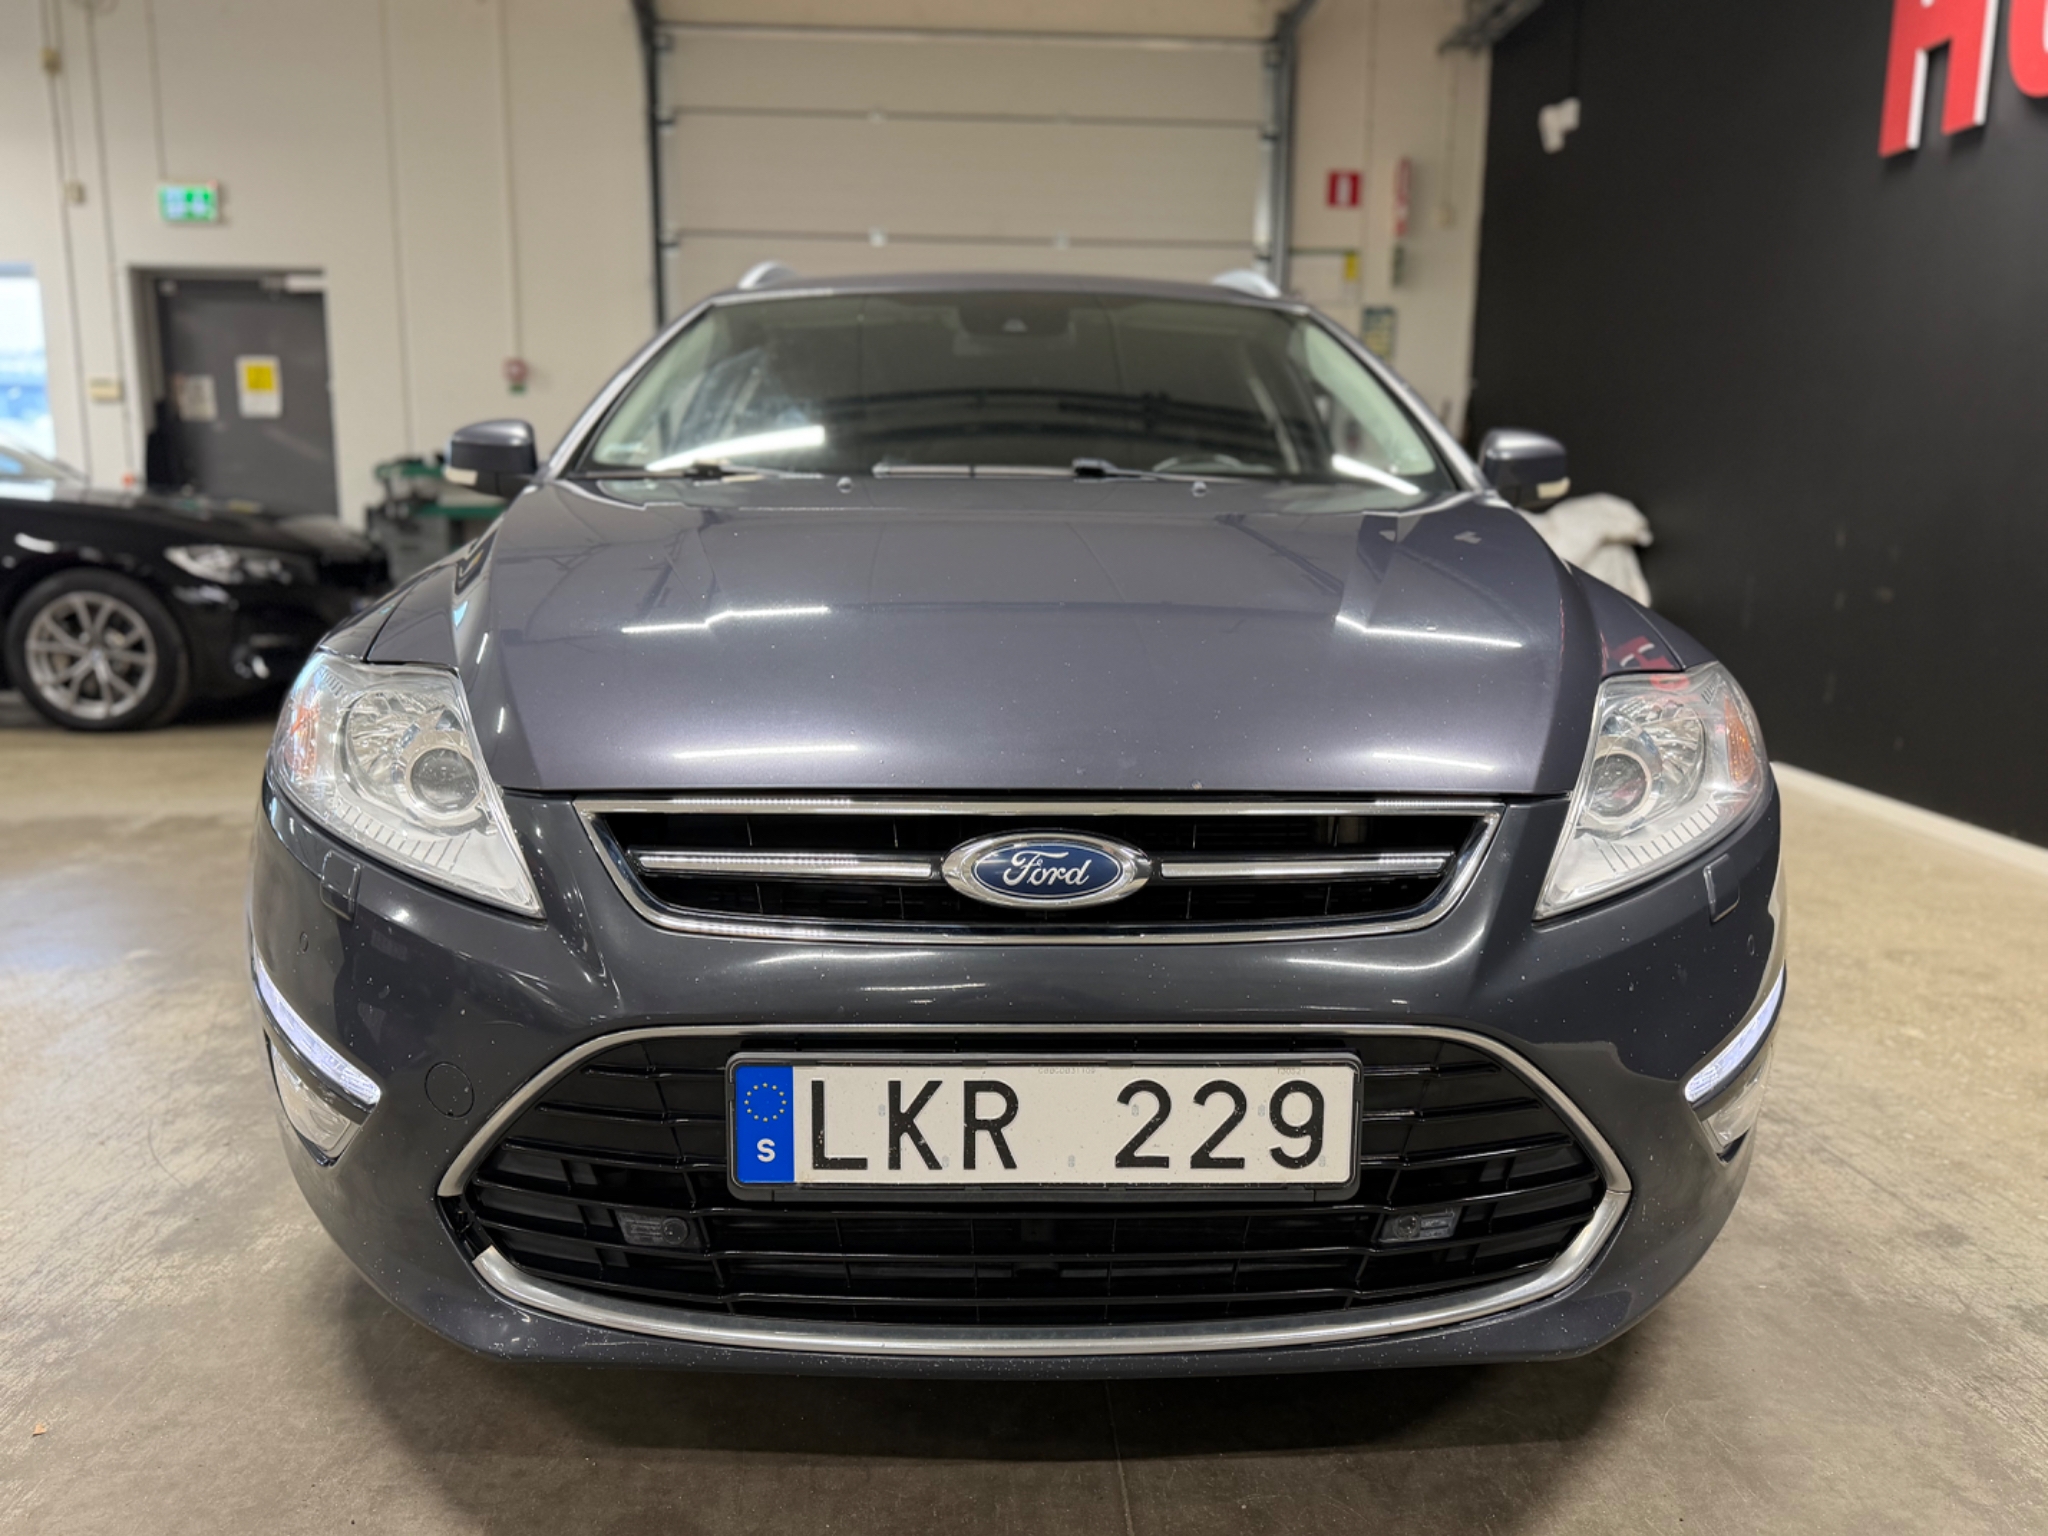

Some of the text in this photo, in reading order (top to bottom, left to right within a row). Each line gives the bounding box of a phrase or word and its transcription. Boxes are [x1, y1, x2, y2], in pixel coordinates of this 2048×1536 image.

[1002, 850, 1093, 887] Ford
[812, 1079, 1325, 1171] LKR 229
[756, 1138, 777, 1162] S
